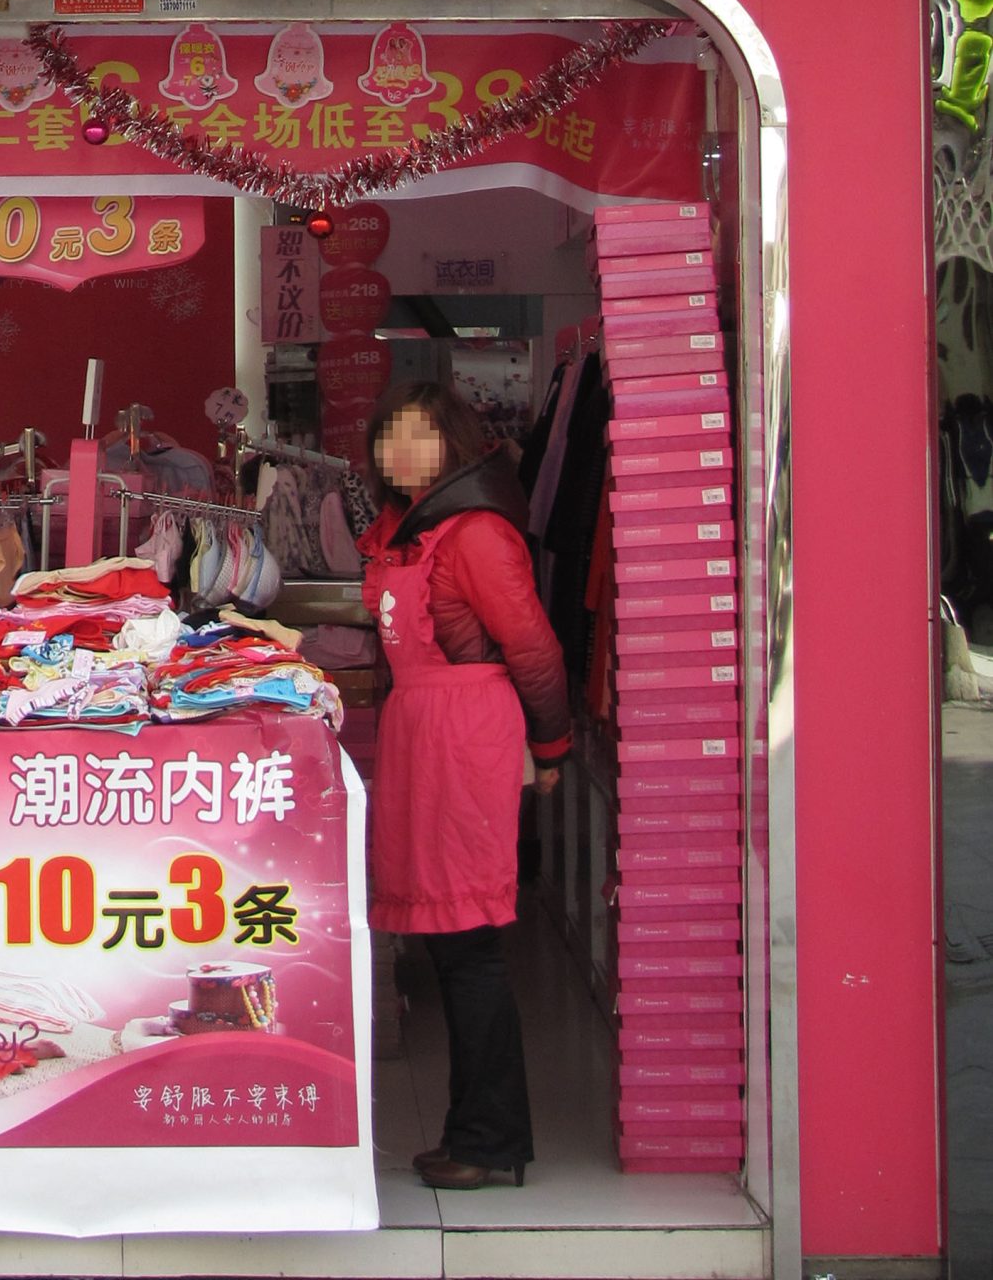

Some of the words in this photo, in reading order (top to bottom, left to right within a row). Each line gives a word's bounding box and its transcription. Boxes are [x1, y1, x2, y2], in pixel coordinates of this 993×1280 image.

[114, 278, 149, 289] WIND
[436, 259, 495, 279] 试衣间
[276, 230, 304, 338] 恕不议价
[9, 751, 296, 826] 潮流内裤
[133, 1083, 321, 1112] 要舒服不要束缚
